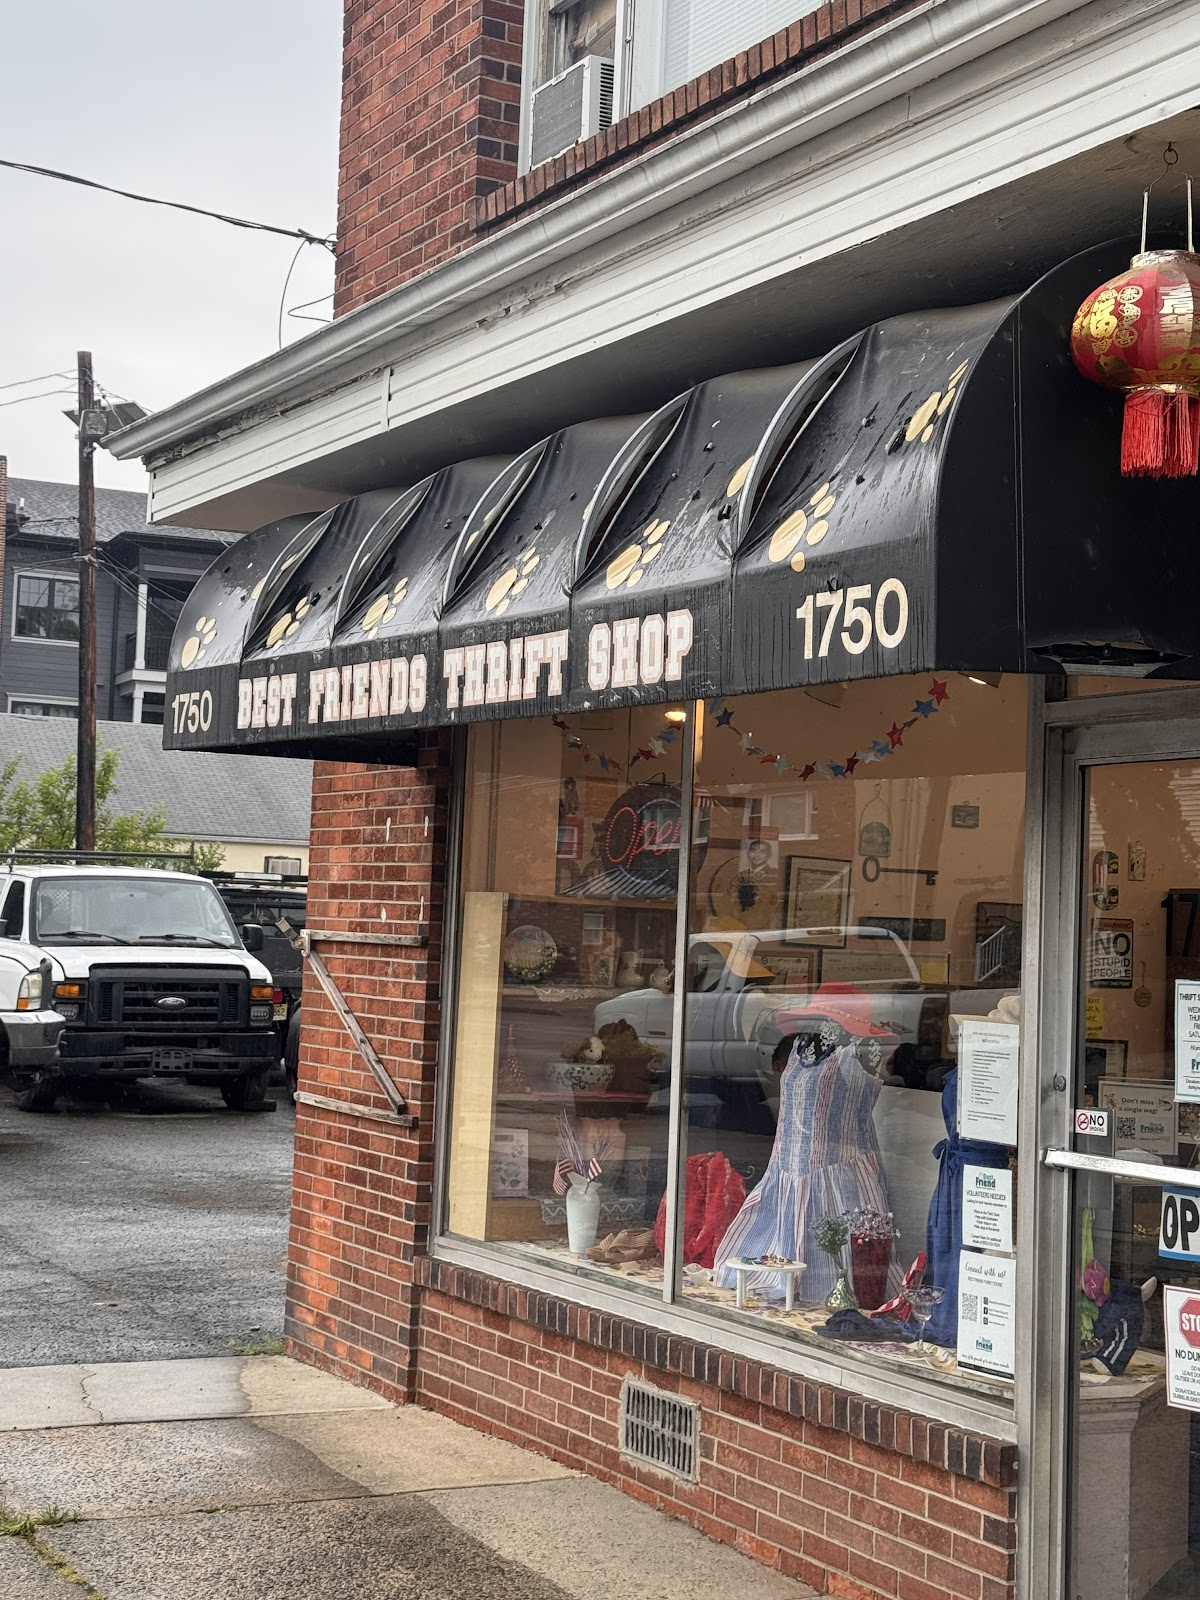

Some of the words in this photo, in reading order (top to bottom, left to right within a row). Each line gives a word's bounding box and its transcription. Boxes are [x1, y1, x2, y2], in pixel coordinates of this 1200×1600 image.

[796, 578, 909, 660] 1750
[237, 673, 297, 729] BEST
[308, 654, 428, 724] FRIENDS
[443, 629, 569, 708] THRIFT
[588, 609, 693, 690] SHOP
[172, 690, 212, 734] 1750
[1103, 922, 1132, 930] WARNING
[1161, 893, 1200, 958] 17
[1094, 932, 1131, 956] NO
[1094, 957, 1131, 967] STUPID
[1093, 968, 1131, 978] PEOPLE
[1179, 993, 1197, 1001] THRIFT
[1143, 1107, 1158, 1115] wag!
[1089, 1114, 1104, 1126] NO
[976, 1177, 995, 1187] Friend
[1163, 1195, 1200, 1251] OP
[965, 1261, 982, 1275] Connect
[984, 1267, 996, 1278] with
[1175, 1348, 1186, 1359] NO
